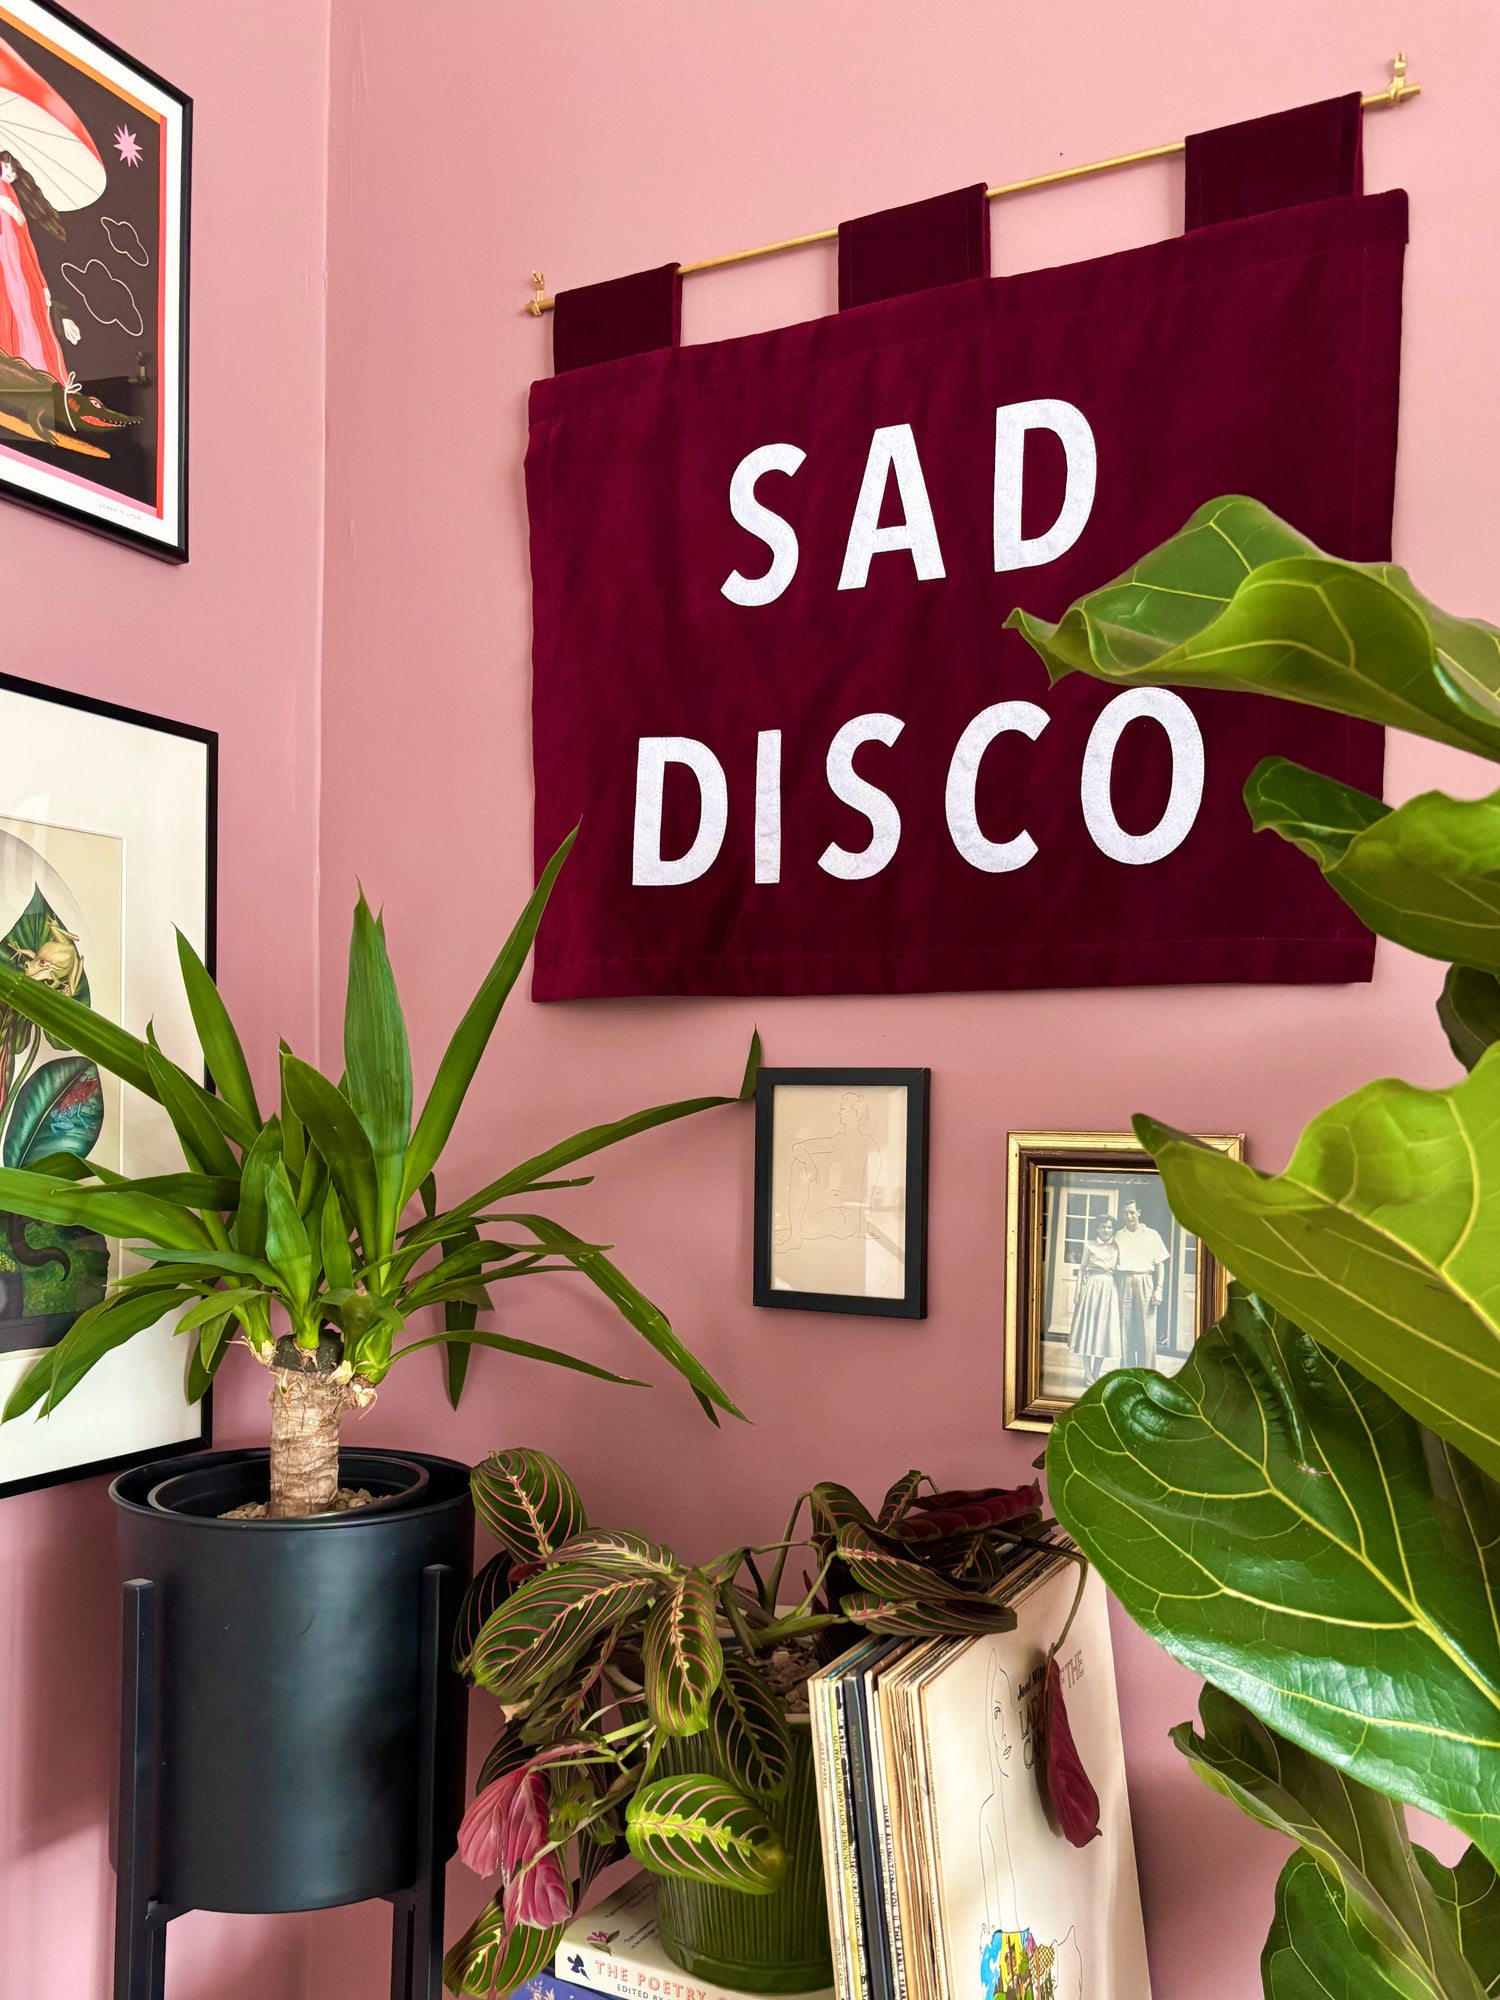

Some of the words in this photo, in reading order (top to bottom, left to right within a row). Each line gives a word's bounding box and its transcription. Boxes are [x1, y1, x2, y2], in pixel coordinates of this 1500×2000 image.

[721, 399, 1097, 606] SAD
[632, 687, 1205, 886] DISCO
[1064, 1649, 1084, 1688] THE
[838, 1791, 846, 1826] WAYLON
[842, 1830, 850, 1870] JENNINGS
[883, 1806, 891, 1828] DUKE
[896, 1946, 904, 1972] EARLY
[594, 1960, 629, 1982] THE
[637, 1972, 707, 2000] POETRY
[617, 1984, 648, 1999] EDITED
